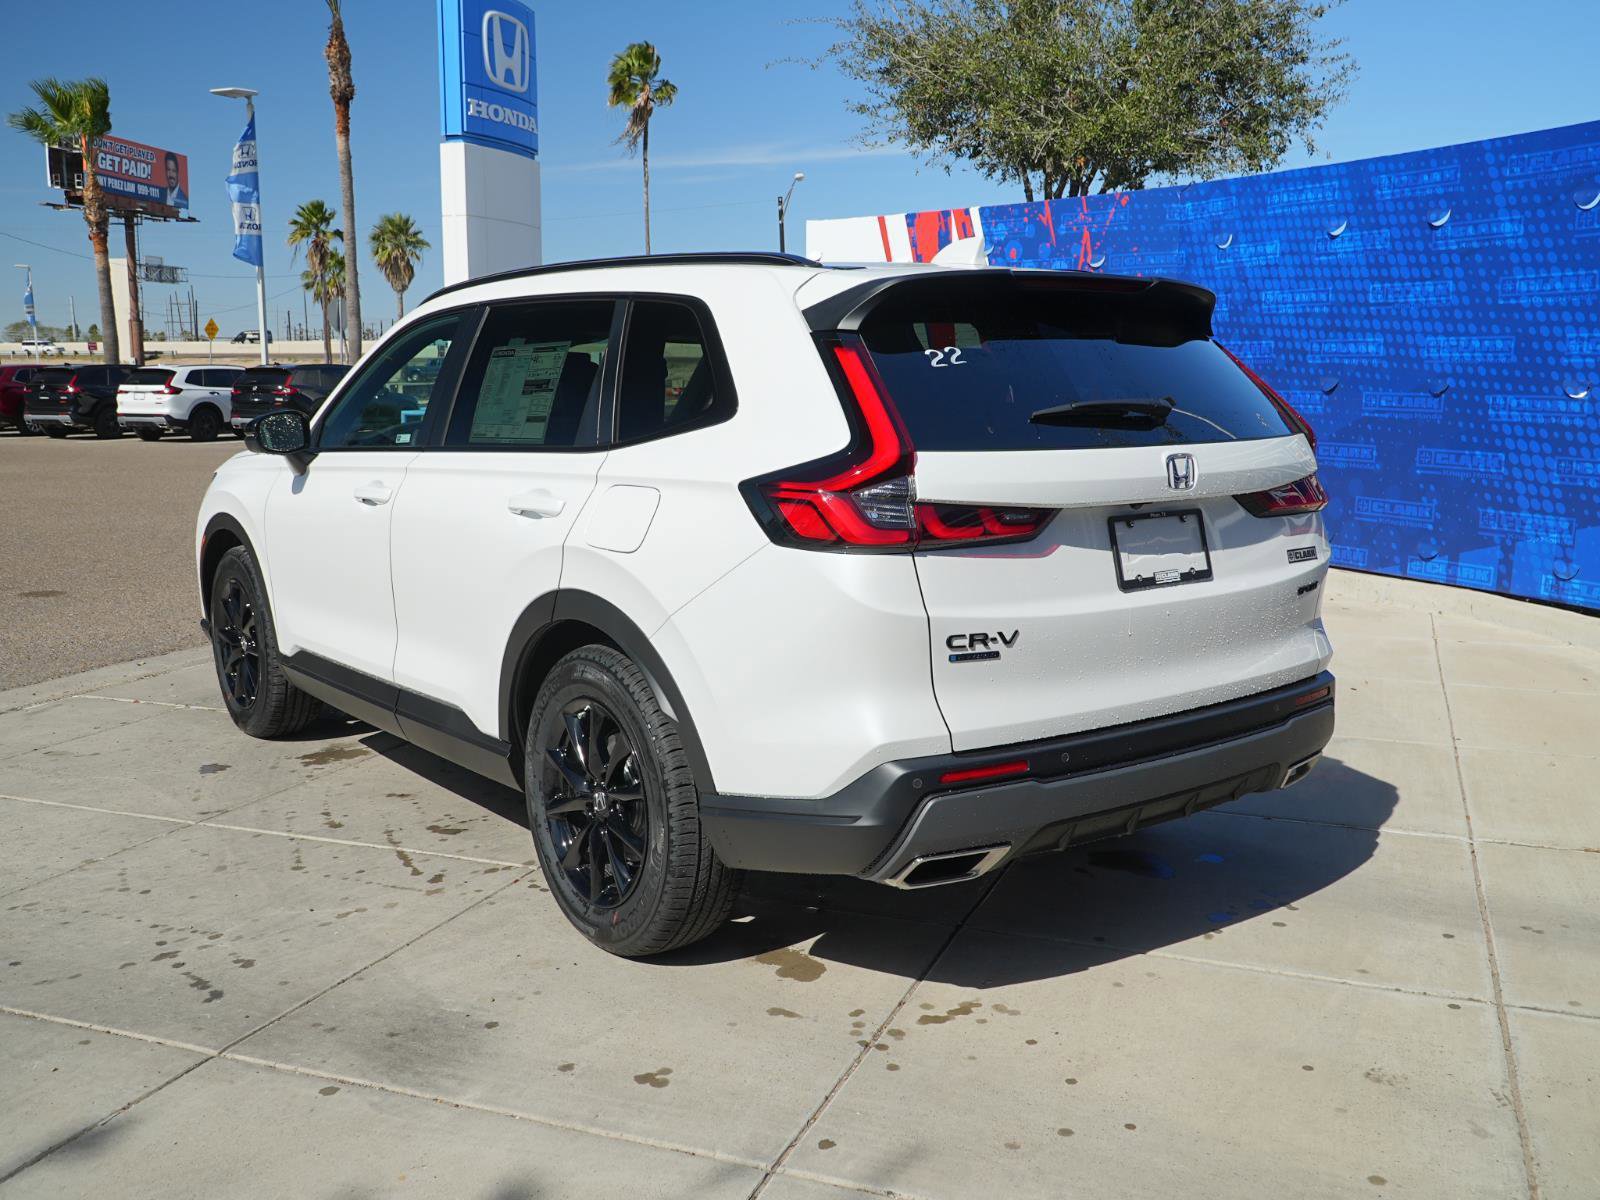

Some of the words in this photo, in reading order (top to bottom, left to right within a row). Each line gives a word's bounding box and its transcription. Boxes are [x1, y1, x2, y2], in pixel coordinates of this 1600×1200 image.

[467, 98, 538, 134] HONDA
[115, 143, 128, 155] GET
[98, 152, 121, 172] GET
[122, 157, 152, 179] PAID!
[924, 346, 967, 368] 22
[946, 629, 1020, 650] CR-V
